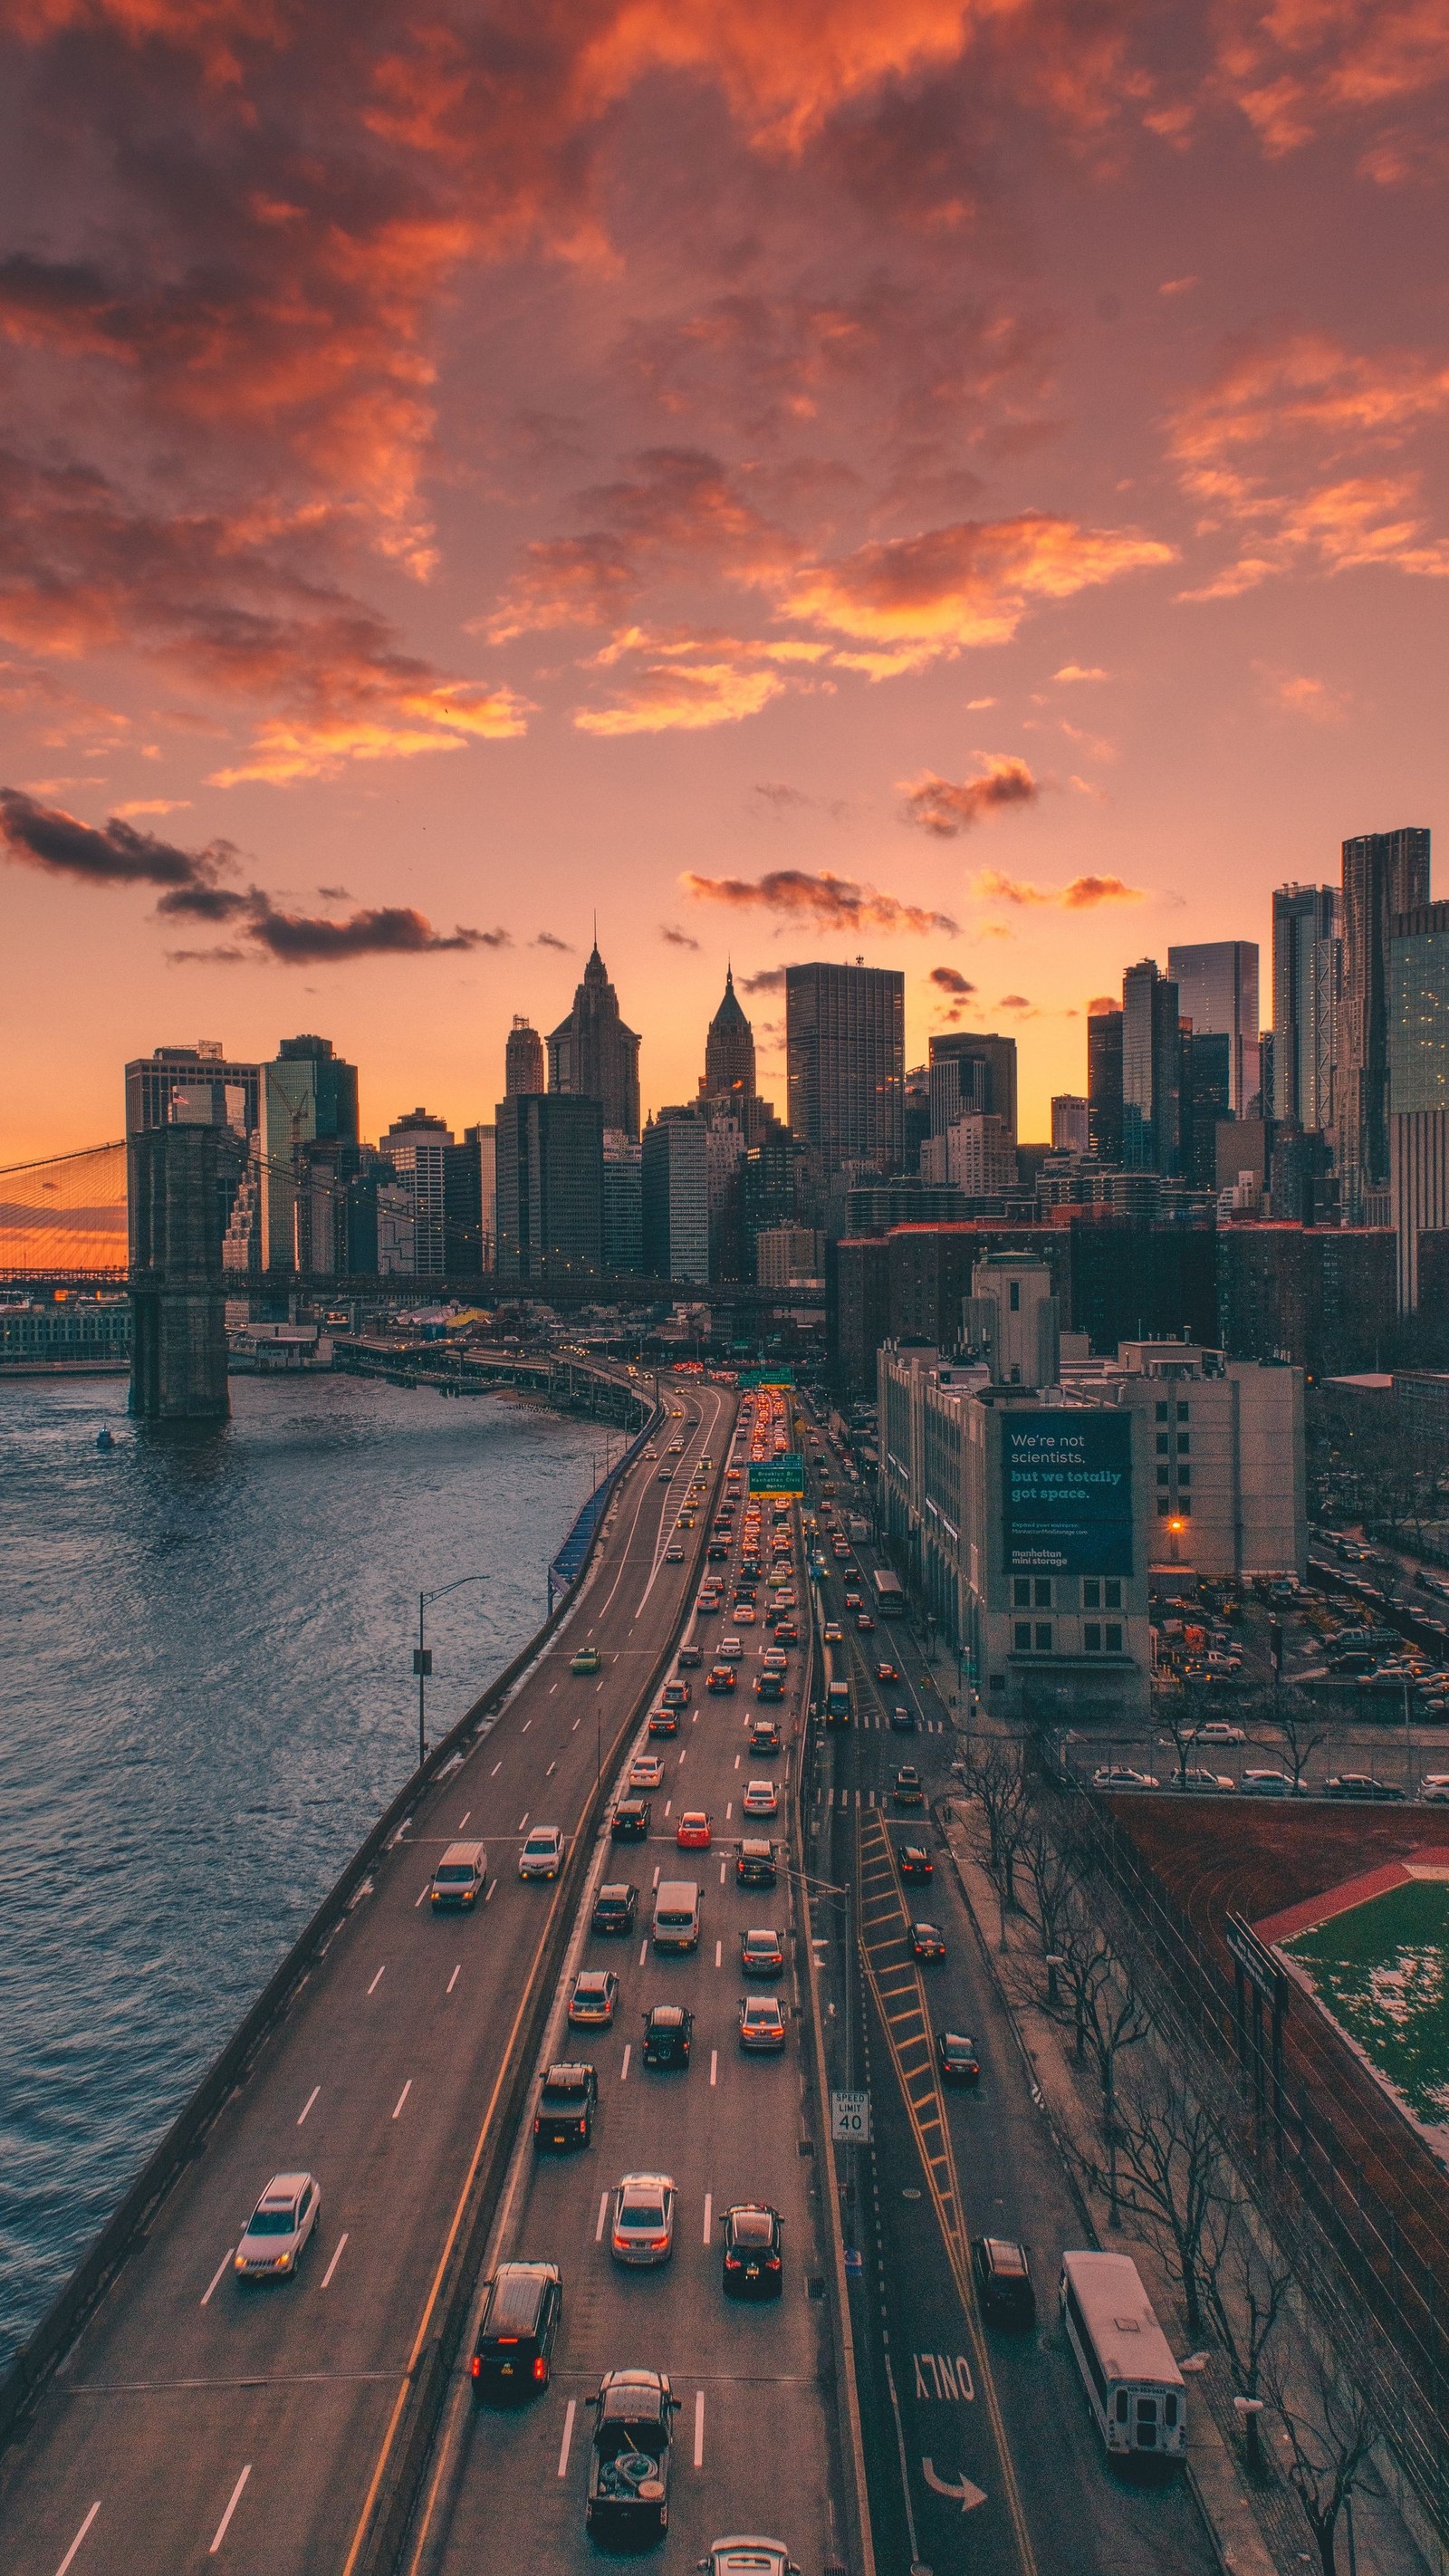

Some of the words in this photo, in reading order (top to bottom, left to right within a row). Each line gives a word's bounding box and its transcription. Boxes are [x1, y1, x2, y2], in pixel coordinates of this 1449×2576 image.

[1011, 1434, 1056, 1447] We're
[1060, 1436, 1085, 1447] not
[1011, 1450, 1086, 1464] scientists,
[1011, 1470, 1039, 1483] but
[1041, 1472, 1065, 1483] we
[1068, 1471, 1121, 1485] totally
[1011, 1487, 1038, 1503] got
[1041, 1489, 1089, 1502] space.
[1012, 1547, 1062, 1558] manhattan
[1012, 1557, 1032, 1565] mini
[1032, 1557, 1068, 1567] storage
[837, 2094, 864, 2102] SPEED
[840, 2104, 861, 2112] LIMIT
[840, 2115, 861, 2130] 40
[913, 2353, 974, 2401] ONLY
